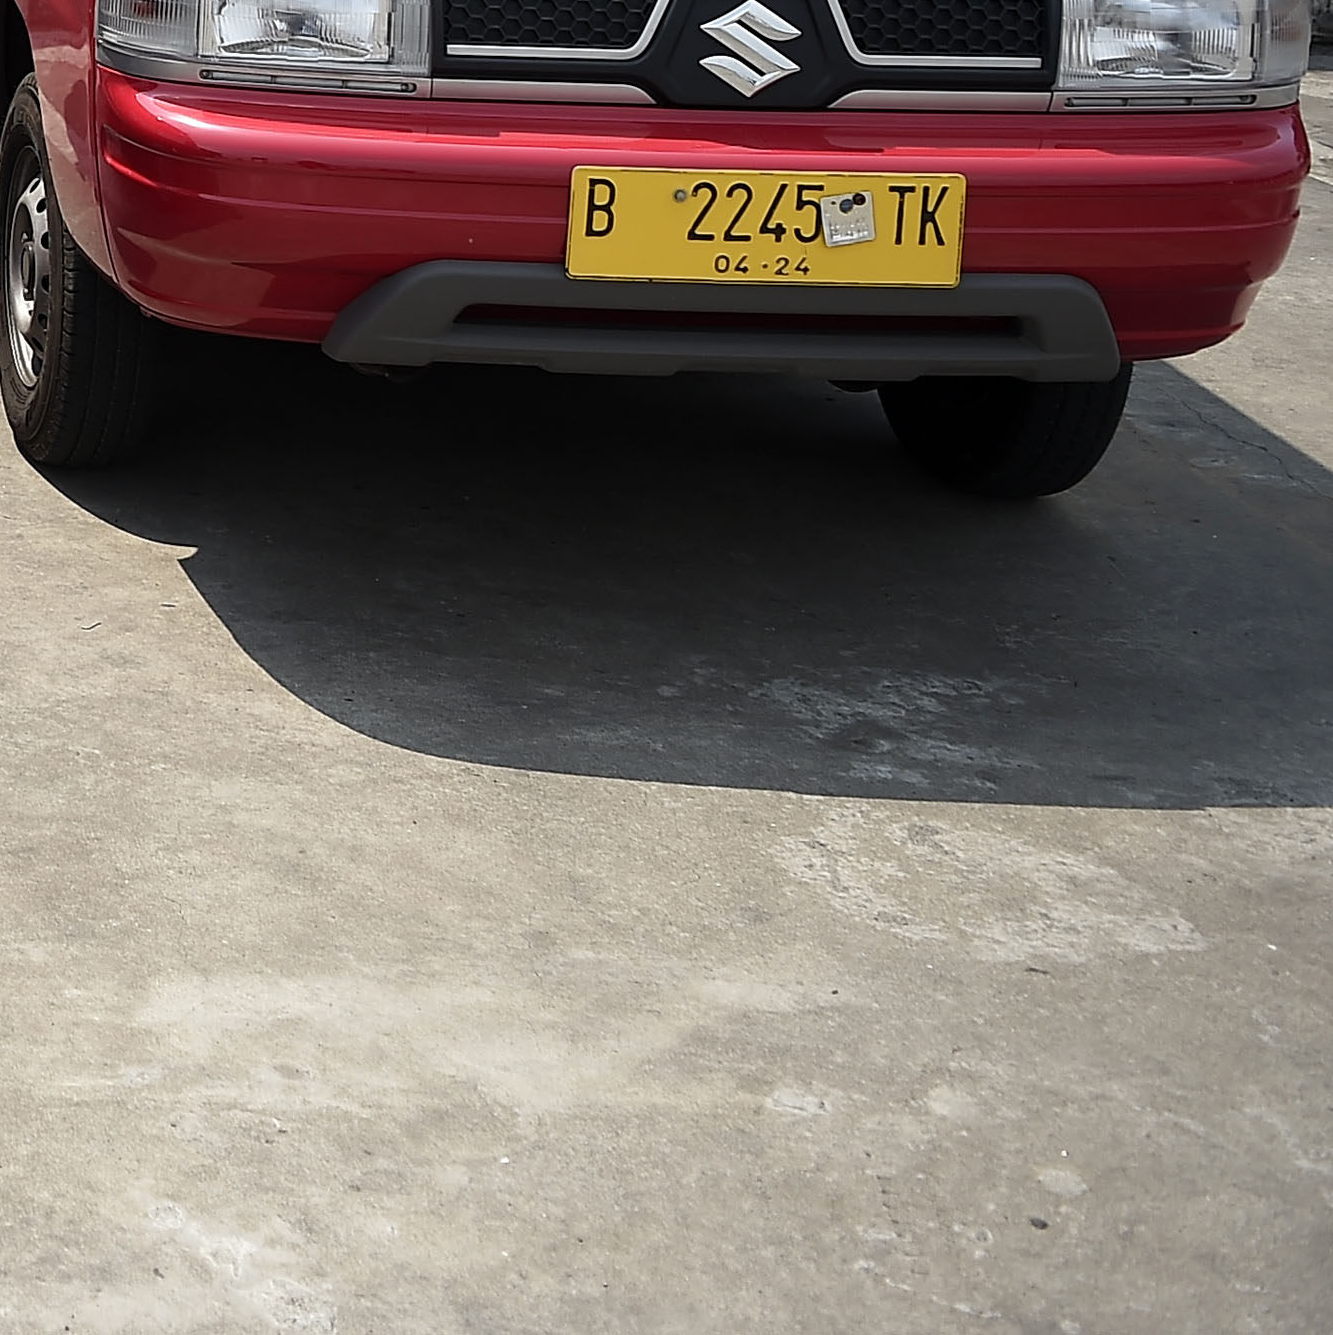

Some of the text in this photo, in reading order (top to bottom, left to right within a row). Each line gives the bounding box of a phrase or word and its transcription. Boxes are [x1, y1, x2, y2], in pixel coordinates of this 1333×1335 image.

[585, 178, 950, 246] B 2245 TK
